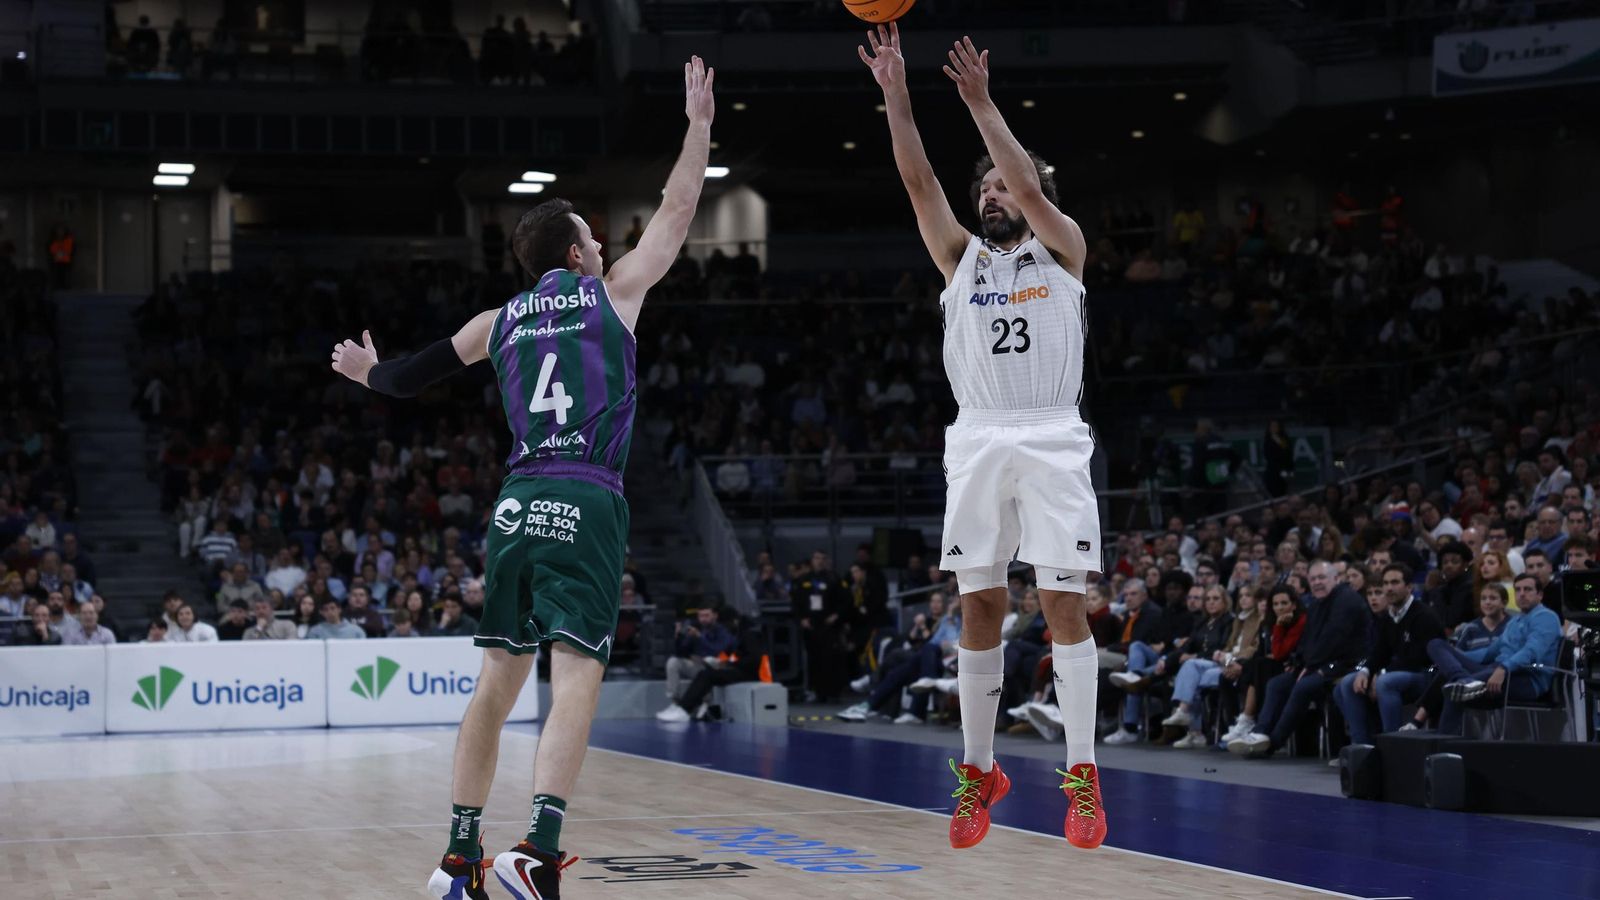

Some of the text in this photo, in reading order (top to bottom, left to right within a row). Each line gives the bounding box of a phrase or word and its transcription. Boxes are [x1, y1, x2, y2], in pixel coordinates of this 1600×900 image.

[506, 286, 597, 321] Kalinoski
[969, 285, 1050, 306] AUTOHERO
[991, 317, 1031, 355] 23
[528, 352, 574, 425] 4
[526, 513, 578, 532] DEL SOL
[530, 500, 581, 520] COSTA
[524, 524, 575, 544] MÁLAGA
[192, 678, 304, 710] Unicaja
[408, 670, 479, 695] Unic
[0, 684, 90, 711] Unicaja
[579, 854, 758, 883] liga
